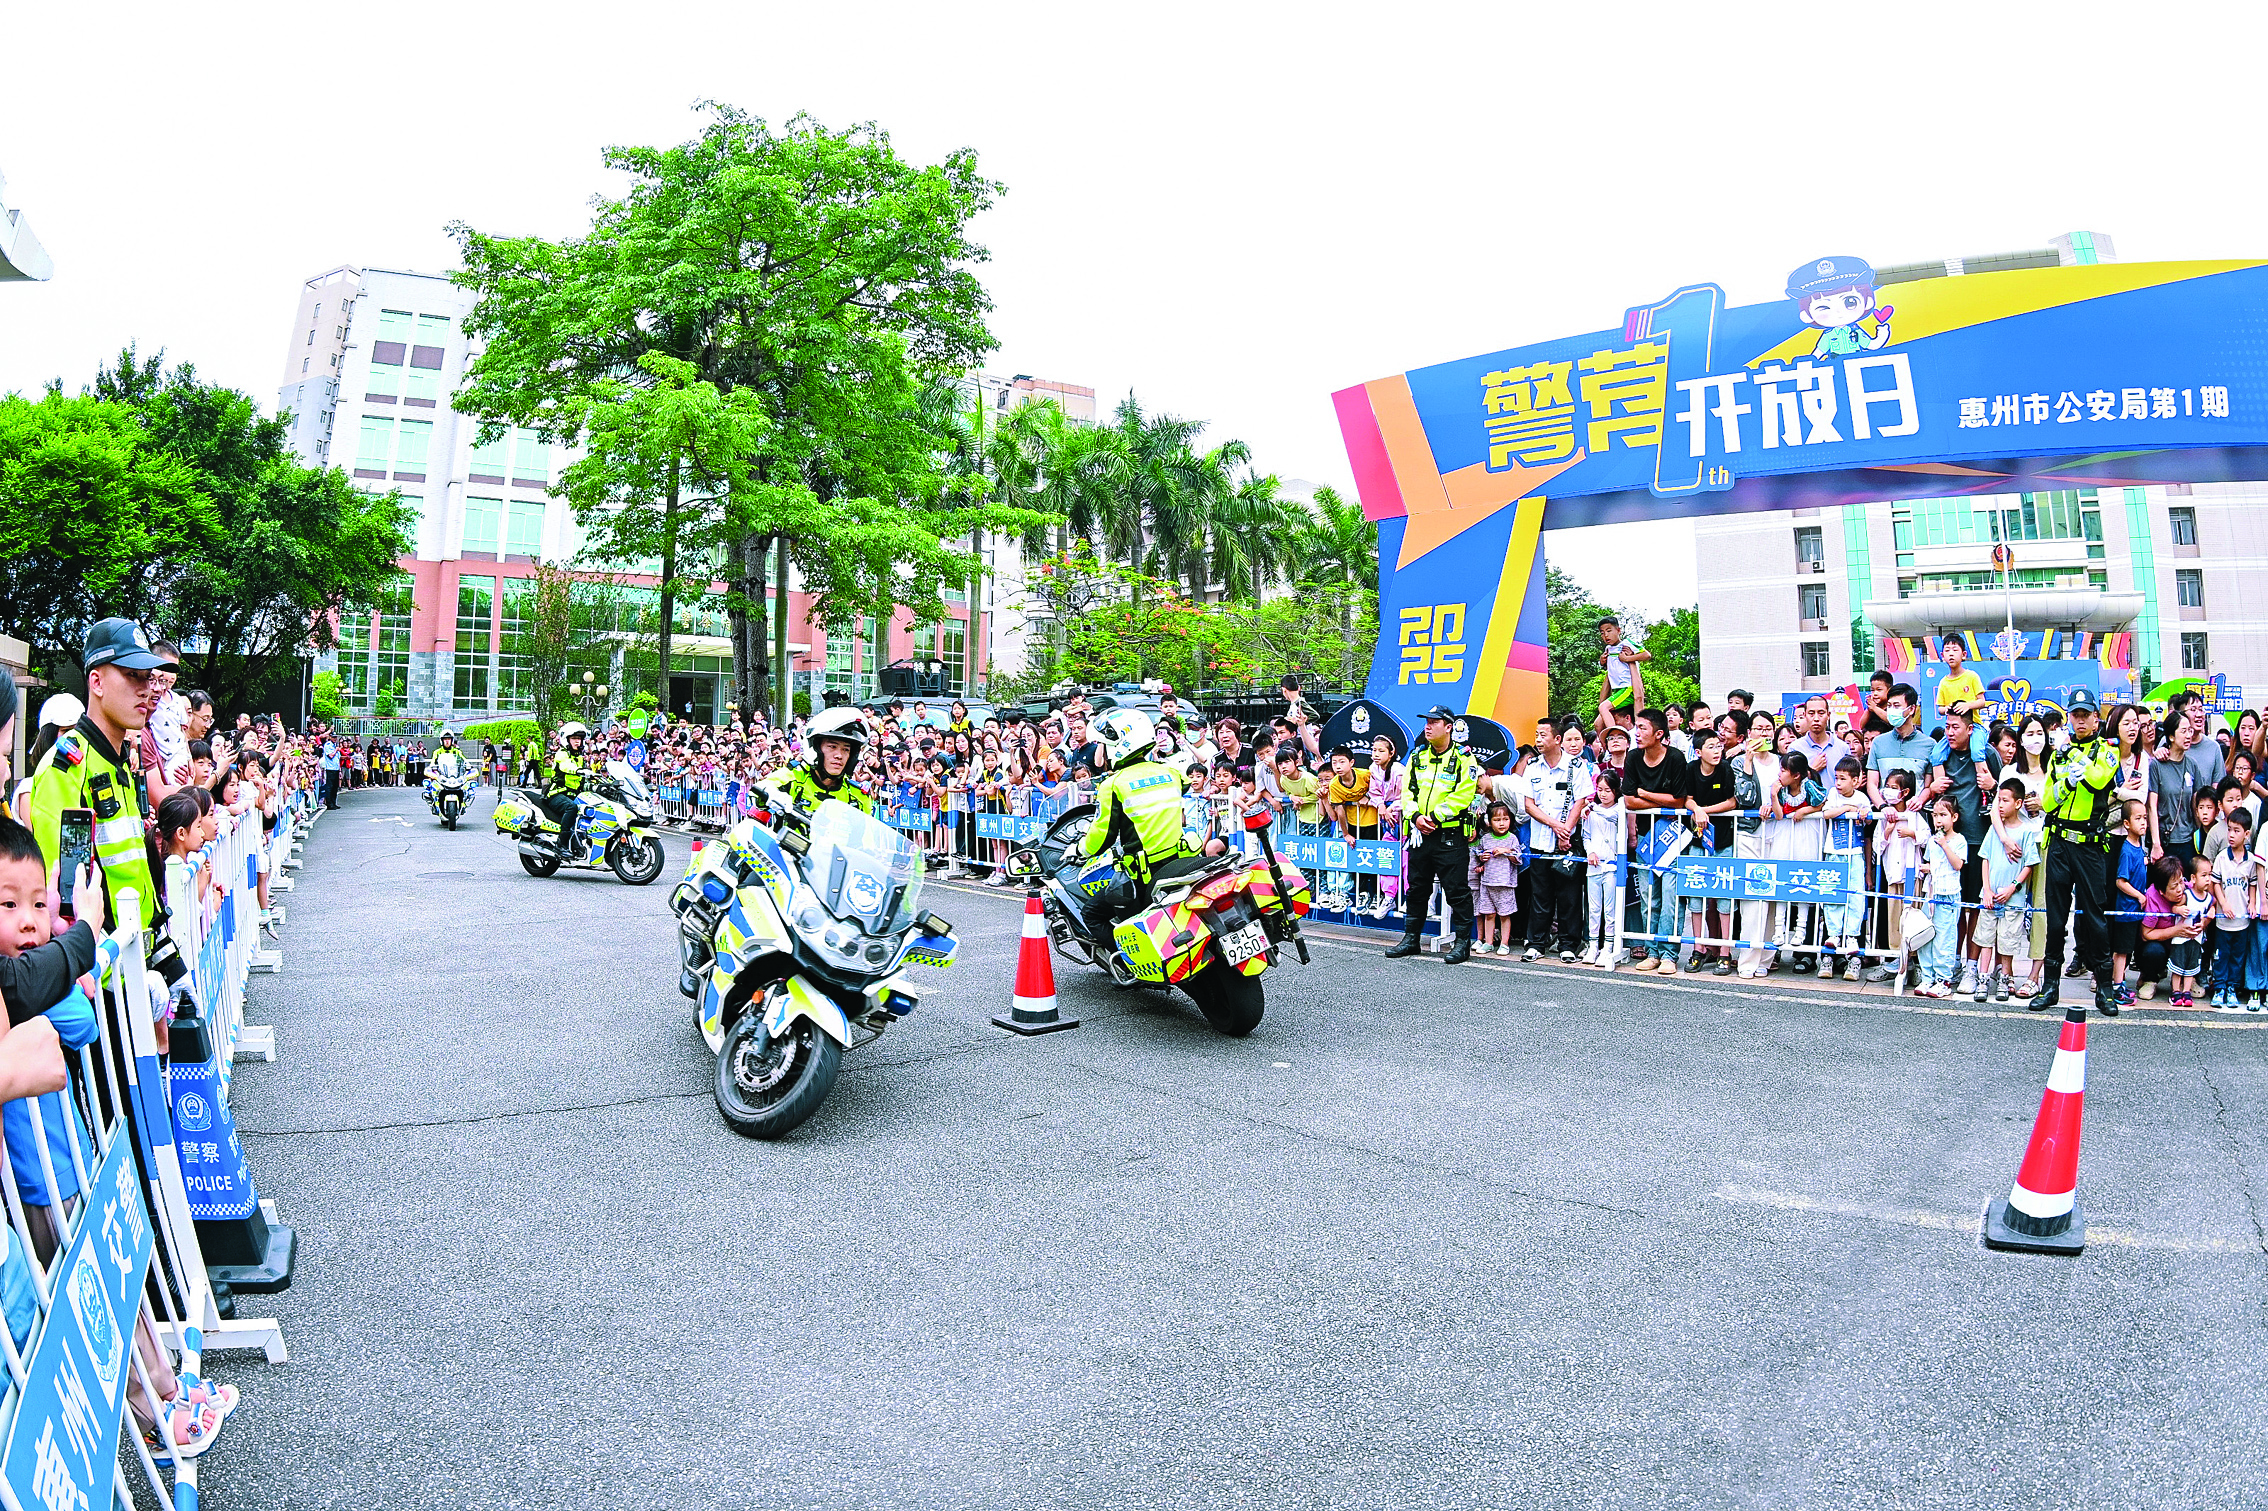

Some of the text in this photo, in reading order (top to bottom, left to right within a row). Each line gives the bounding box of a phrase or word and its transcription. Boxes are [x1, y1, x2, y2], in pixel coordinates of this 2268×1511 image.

[1675, 351, 1921, 459] 开放日
[1957, 385, 2231, 429] 惠州市公安局第1期
[1283, 841, 1395, 869] 惠州 交警
[1683, 864, 1842, 896] 惠州 交警
[181, 1140, 220, 1164] 警察
[187, 1175, 233, 1193] POLICE
